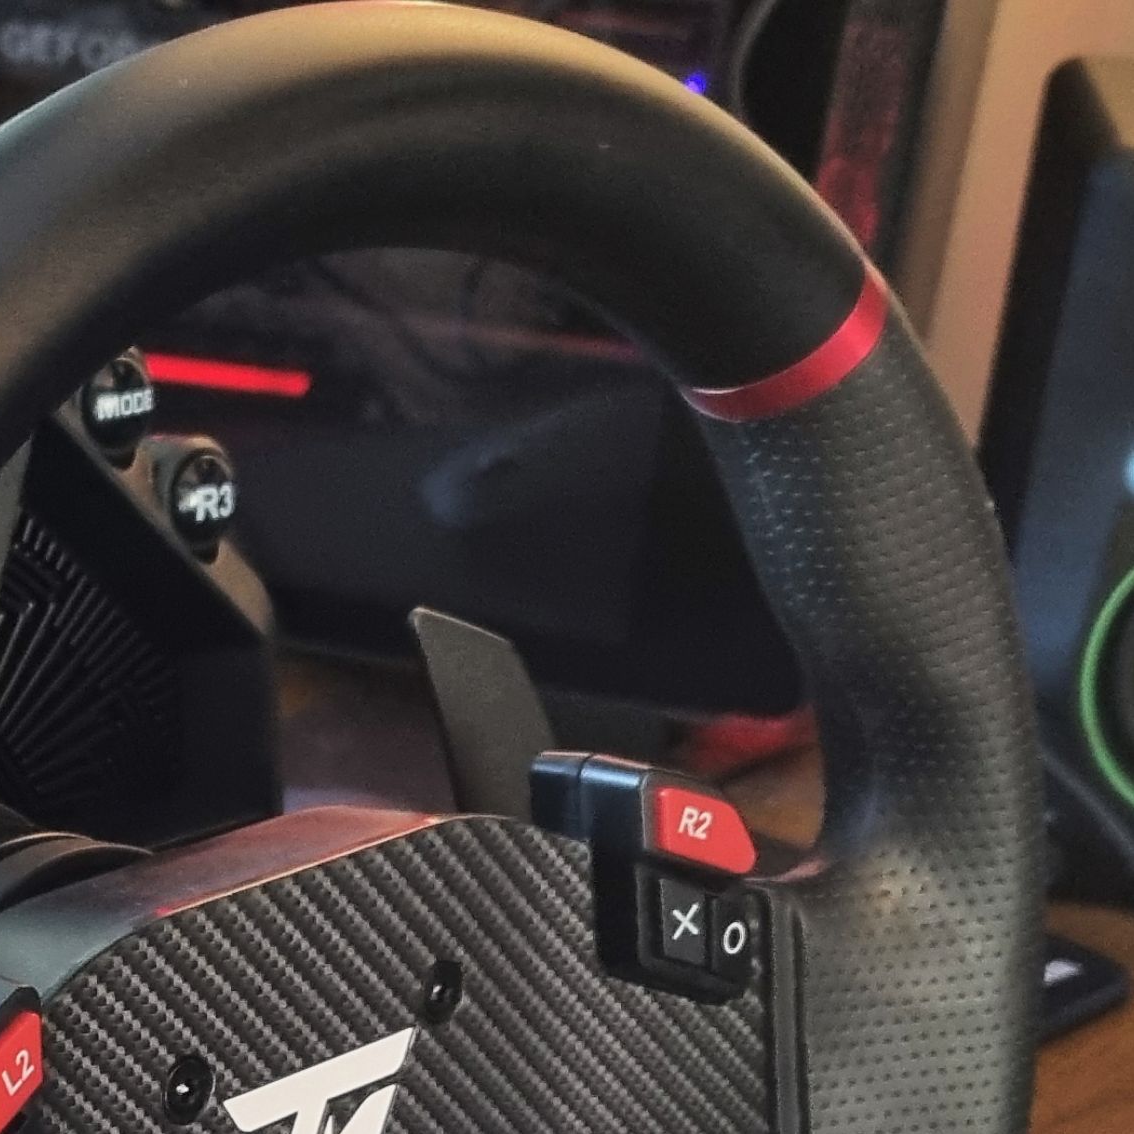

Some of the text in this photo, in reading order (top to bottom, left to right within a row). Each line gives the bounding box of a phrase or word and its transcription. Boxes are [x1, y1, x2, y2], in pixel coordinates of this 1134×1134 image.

[193, 482, 236, 522] R3
[677, 806, 713, 840] R2
[1, 1049, 35, 1096] L2
